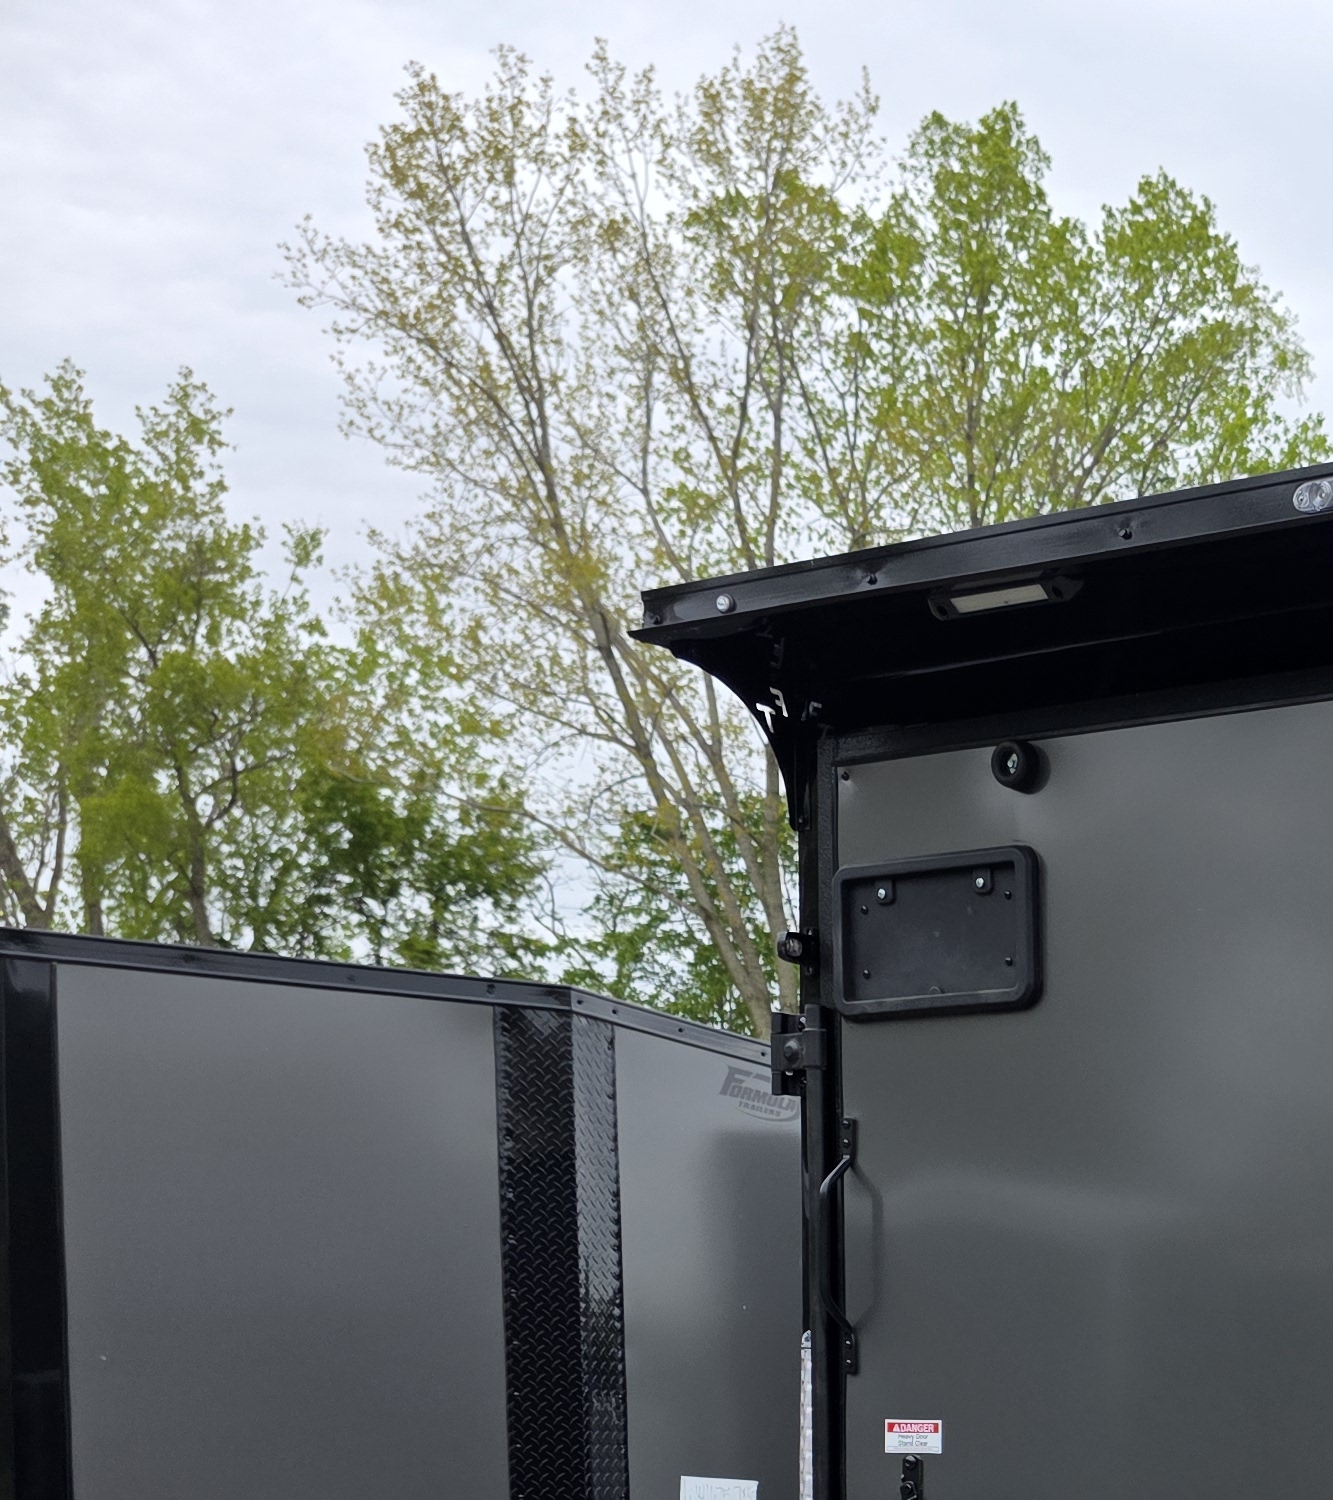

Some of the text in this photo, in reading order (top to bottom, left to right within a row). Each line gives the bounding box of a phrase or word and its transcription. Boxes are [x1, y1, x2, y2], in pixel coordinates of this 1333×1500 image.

[719, 1066, 797, 1112] FORMULA
[738, 1100, 782, 1117] TRAILERS
[900, 1423, 935, 1433] DANGER
